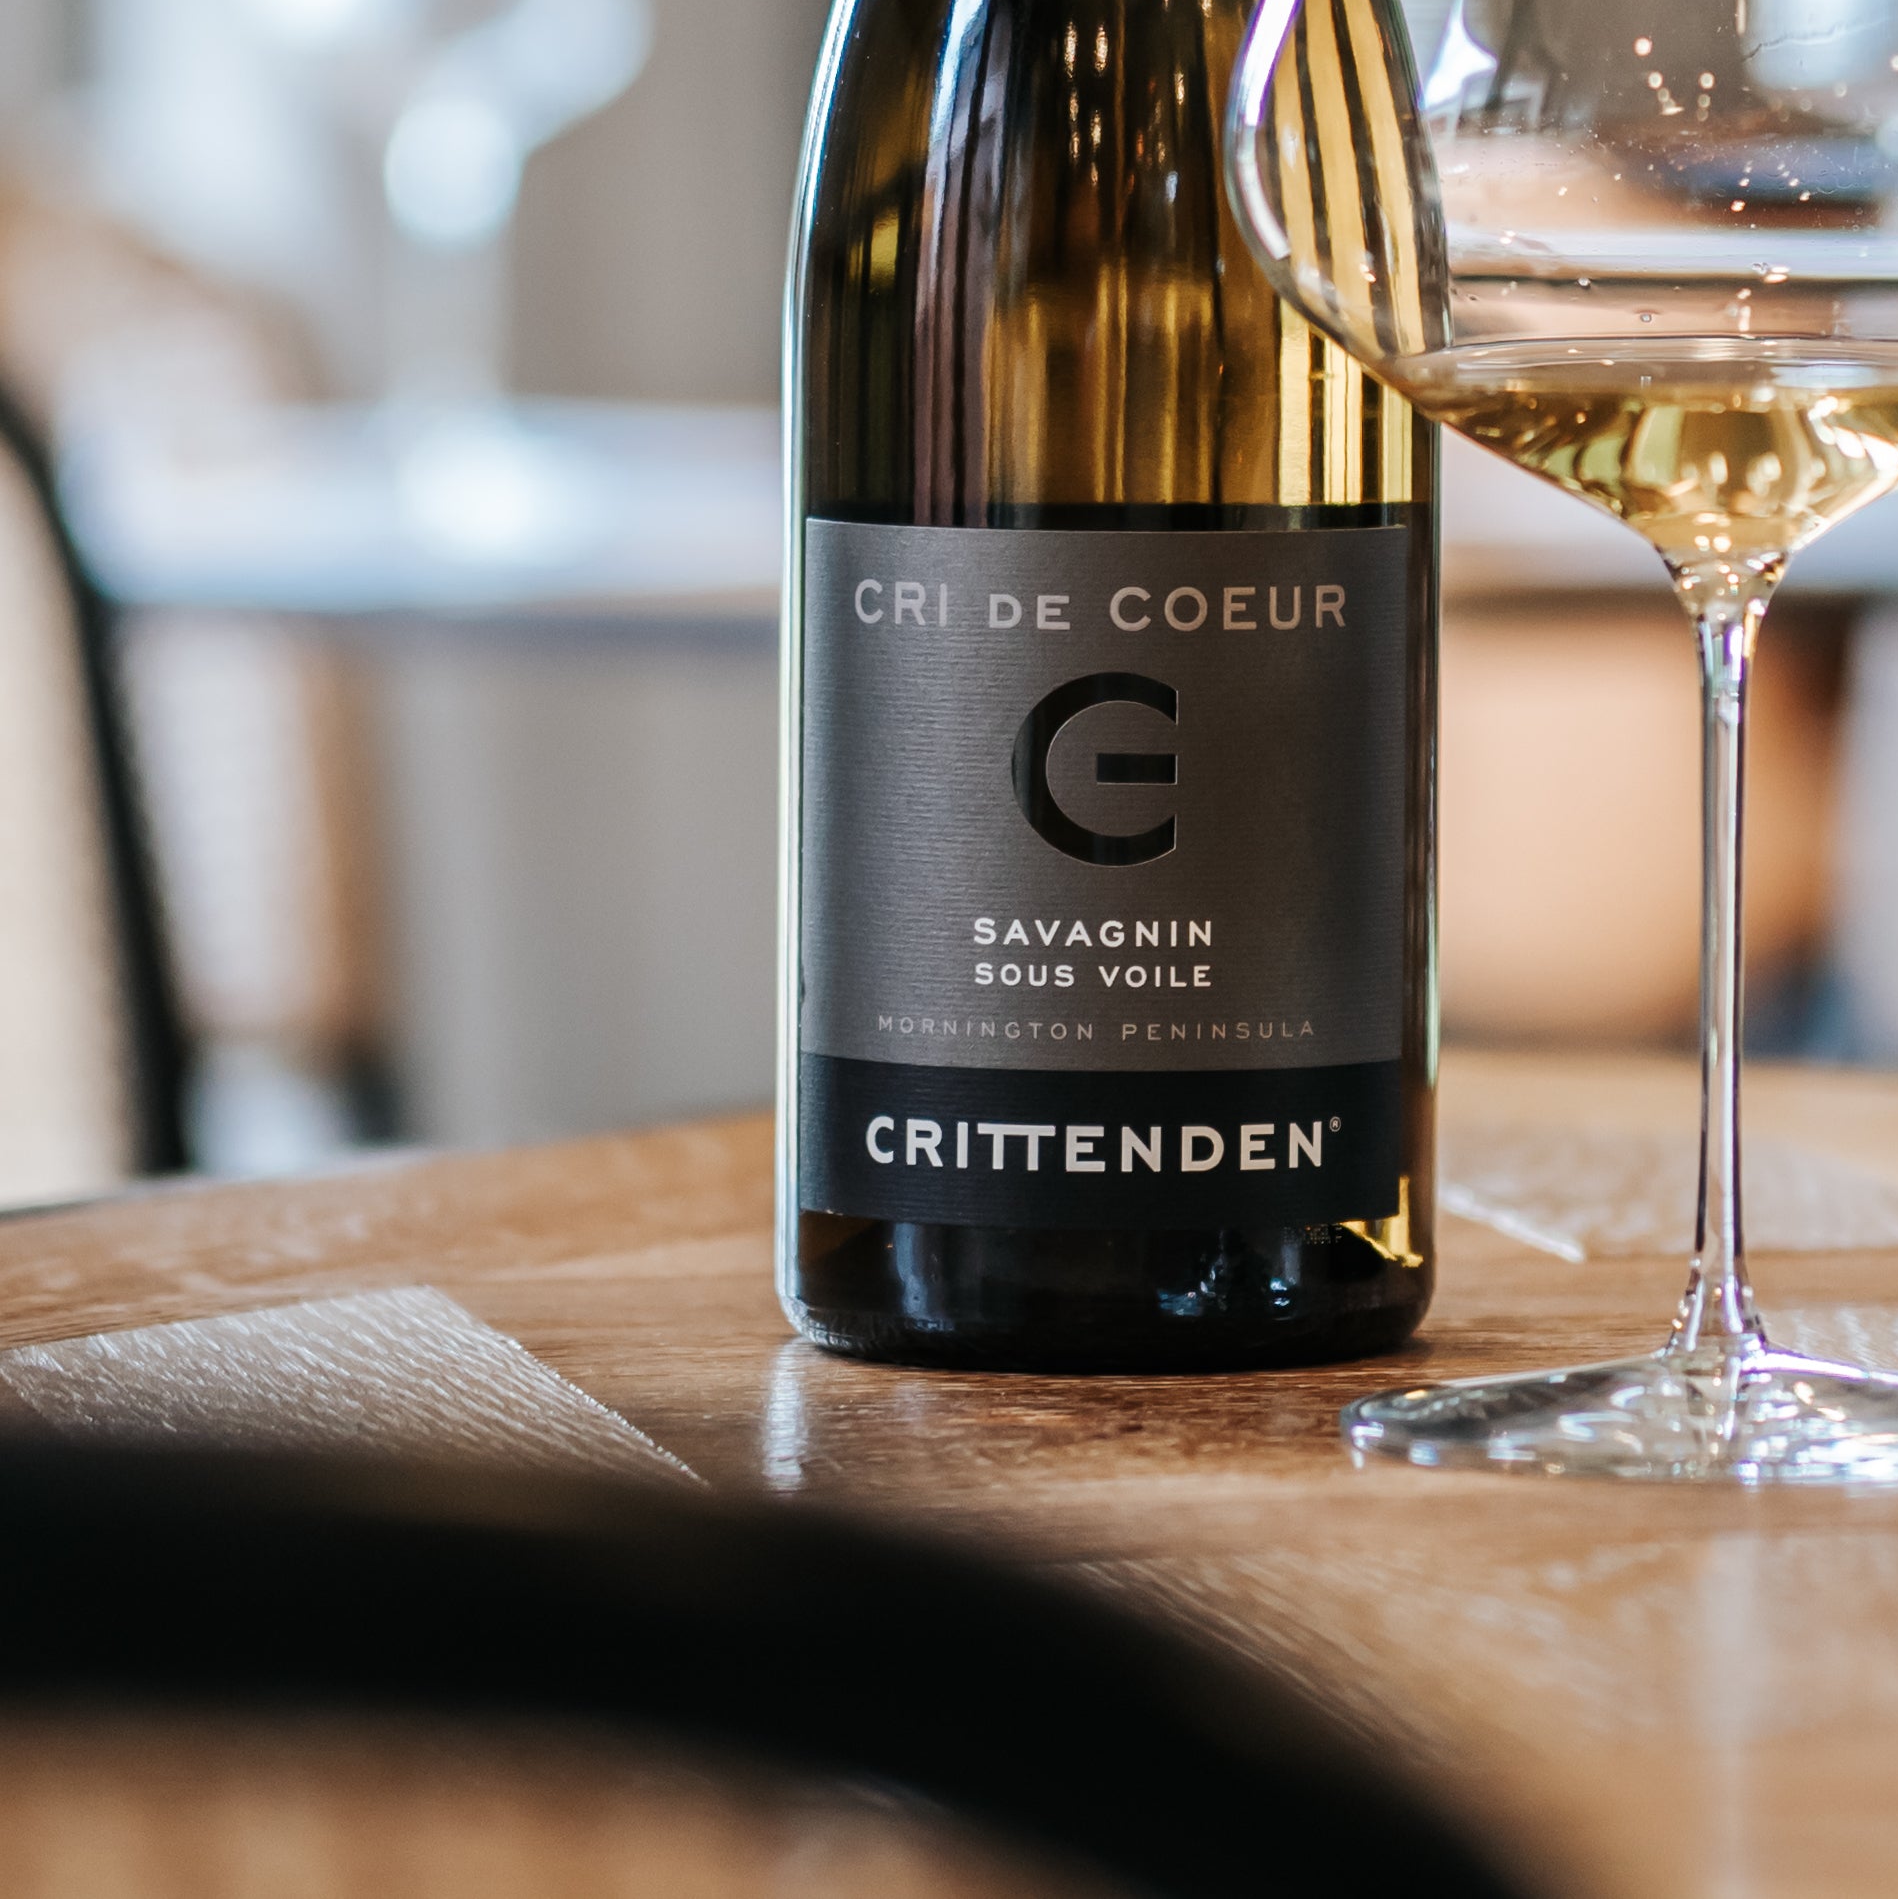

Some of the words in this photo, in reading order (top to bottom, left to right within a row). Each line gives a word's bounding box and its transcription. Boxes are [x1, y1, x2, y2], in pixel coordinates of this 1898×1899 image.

[854, 578, 949, 628] CRI
[987, 593, 1071, 631] DE
[1108, 584, 1346, 632] COEUR
[973, 917, 1212, 948] SAVAGNIN
[974, 962, 1075, 988] SOUS
[1098, 964, 1212, 989] VOILE
[878, 1015, 1093, 1041] MORNINGTON
[1121, 1020, 1314, 1042] PENINSULA
